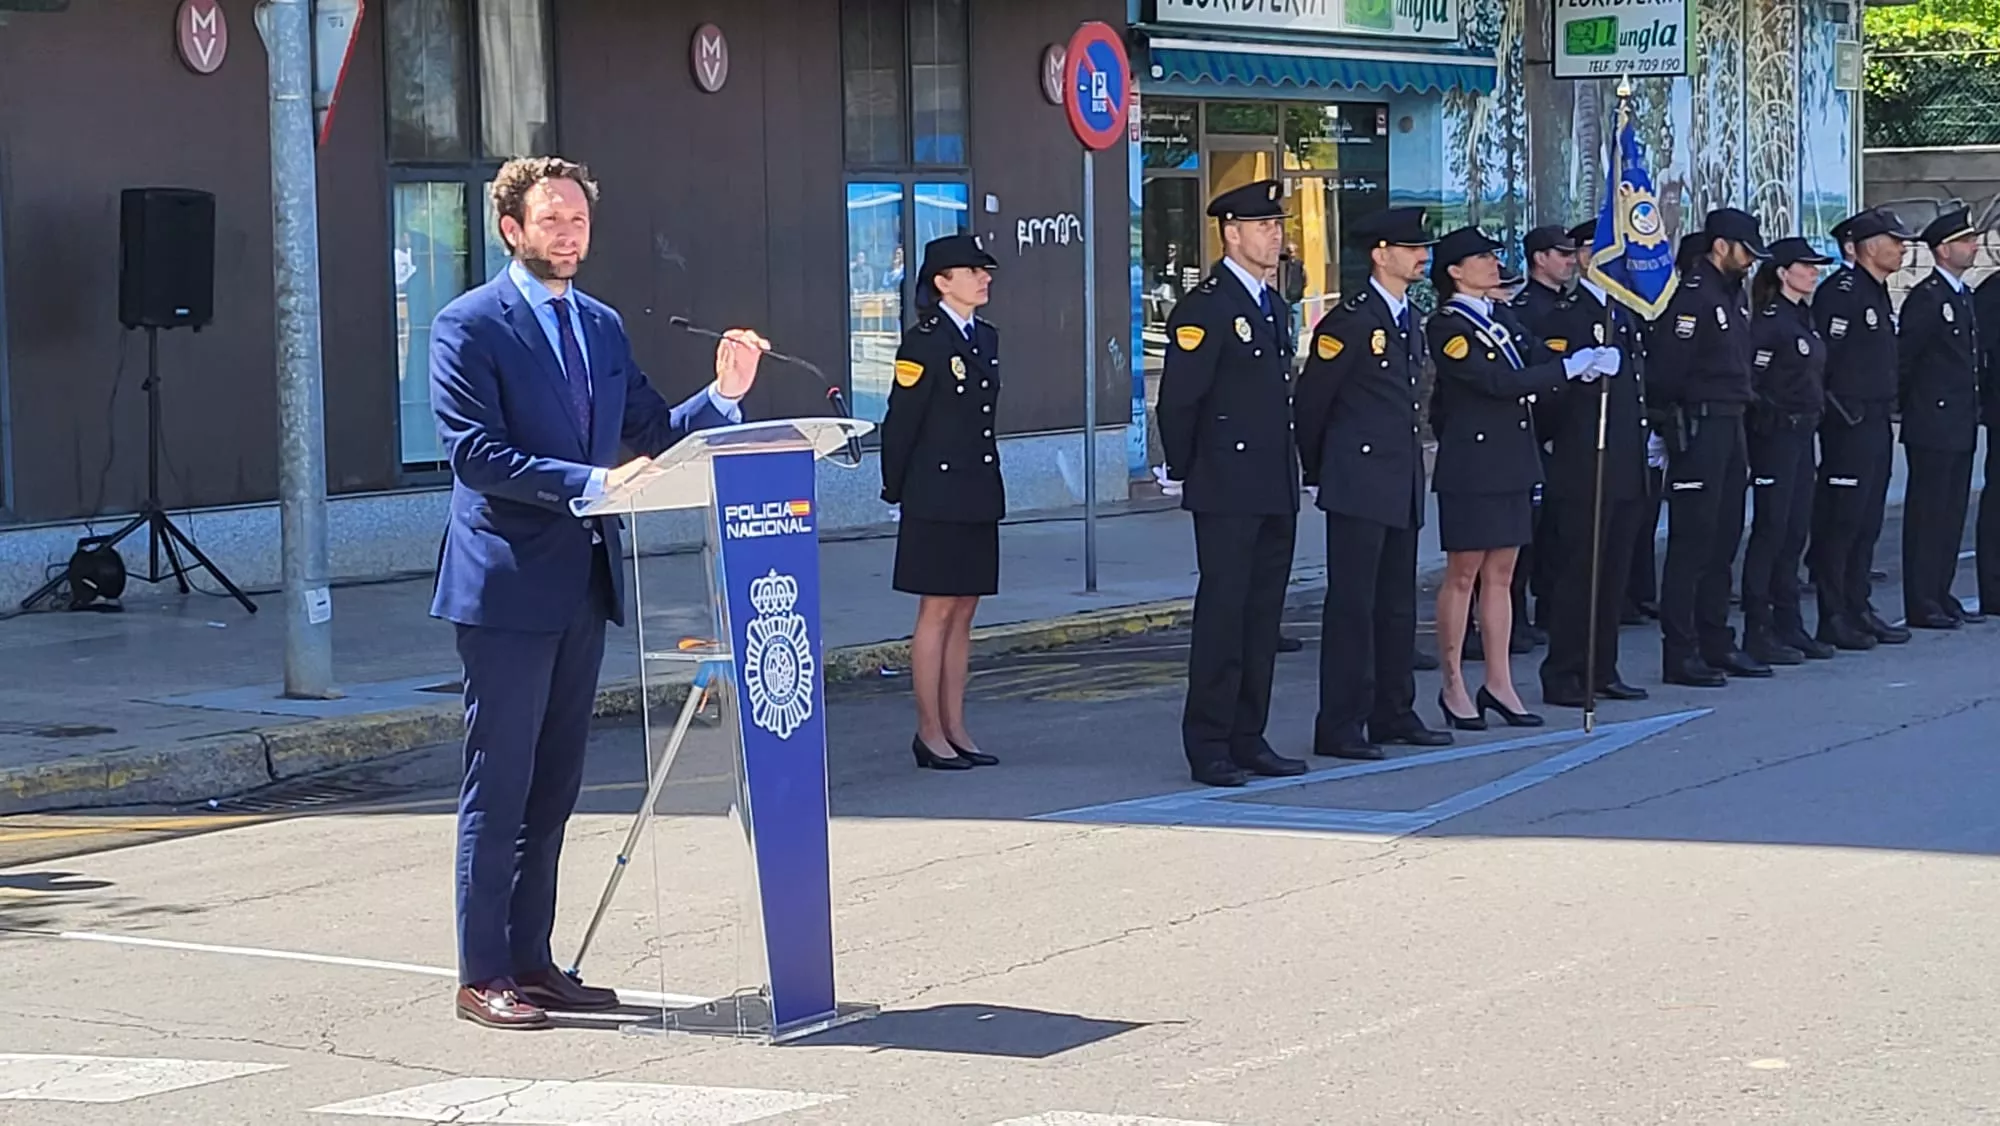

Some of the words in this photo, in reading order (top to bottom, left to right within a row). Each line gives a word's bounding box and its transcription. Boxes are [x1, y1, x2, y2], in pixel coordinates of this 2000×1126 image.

[191, 5, 216, 35] M
[192, 37, 216, 66] V
[702, 34, 720, 59] M
[703, 60, 720, 86] V
[1615, 59, 1635, 73] 974
[1638, 58, 1659, 72] 709
[1661, 57, 1680, 71] 190
[1094, 74, 1105, 97] P
[724, 500, 794, 523] POLICIA
[726, 517, 813, 540] NACIONAL
